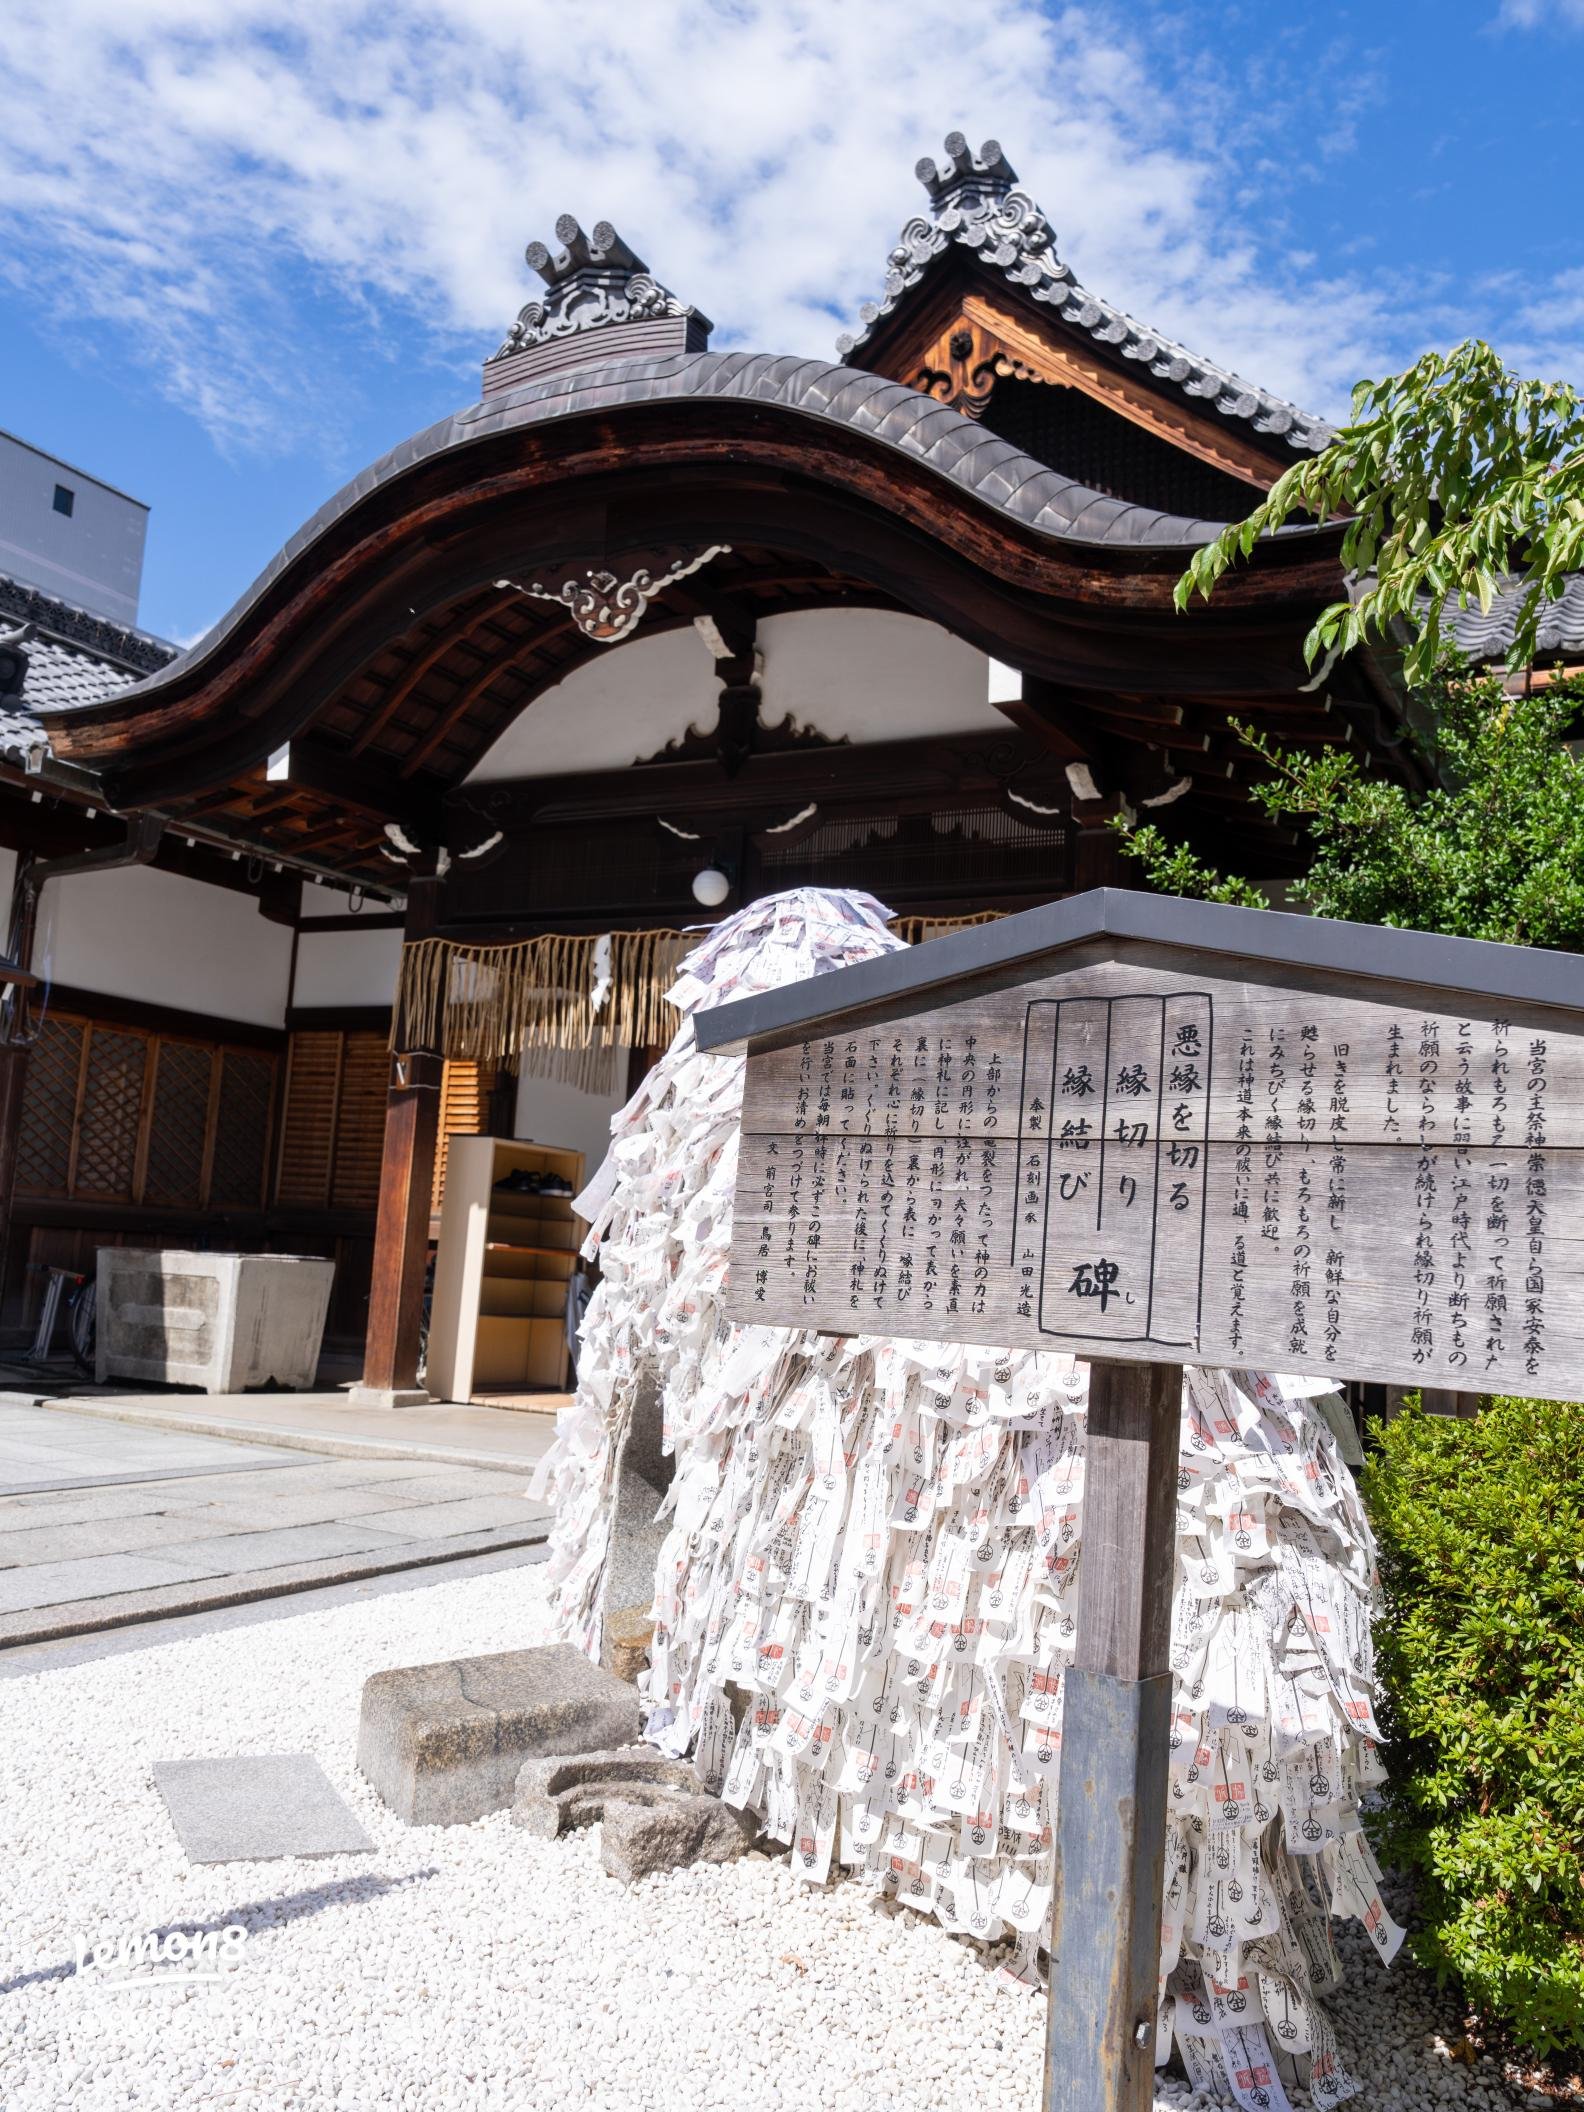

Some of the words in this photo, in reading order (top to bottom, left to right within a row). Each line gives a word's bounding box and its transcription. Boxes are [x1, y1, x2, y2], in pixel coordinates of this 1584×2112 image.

[1028, 1097, 1045, 1131] 奉製
[1059, 1065, 1096, 1201] 縁結び
[1113, 1064, 1151, 1207] 縁切り
[1166, 1024, 1202, 1212] 悪縁を切る
[1261, 1028, 1285, 1252] にみちびく縁結び共に歓迎。
[1384, 1024, 1404, 1142] 生まれました。
[1016, 1248, 1035, 1317] 山田光造
[1068, 1258, 1121, 1314] 碑
